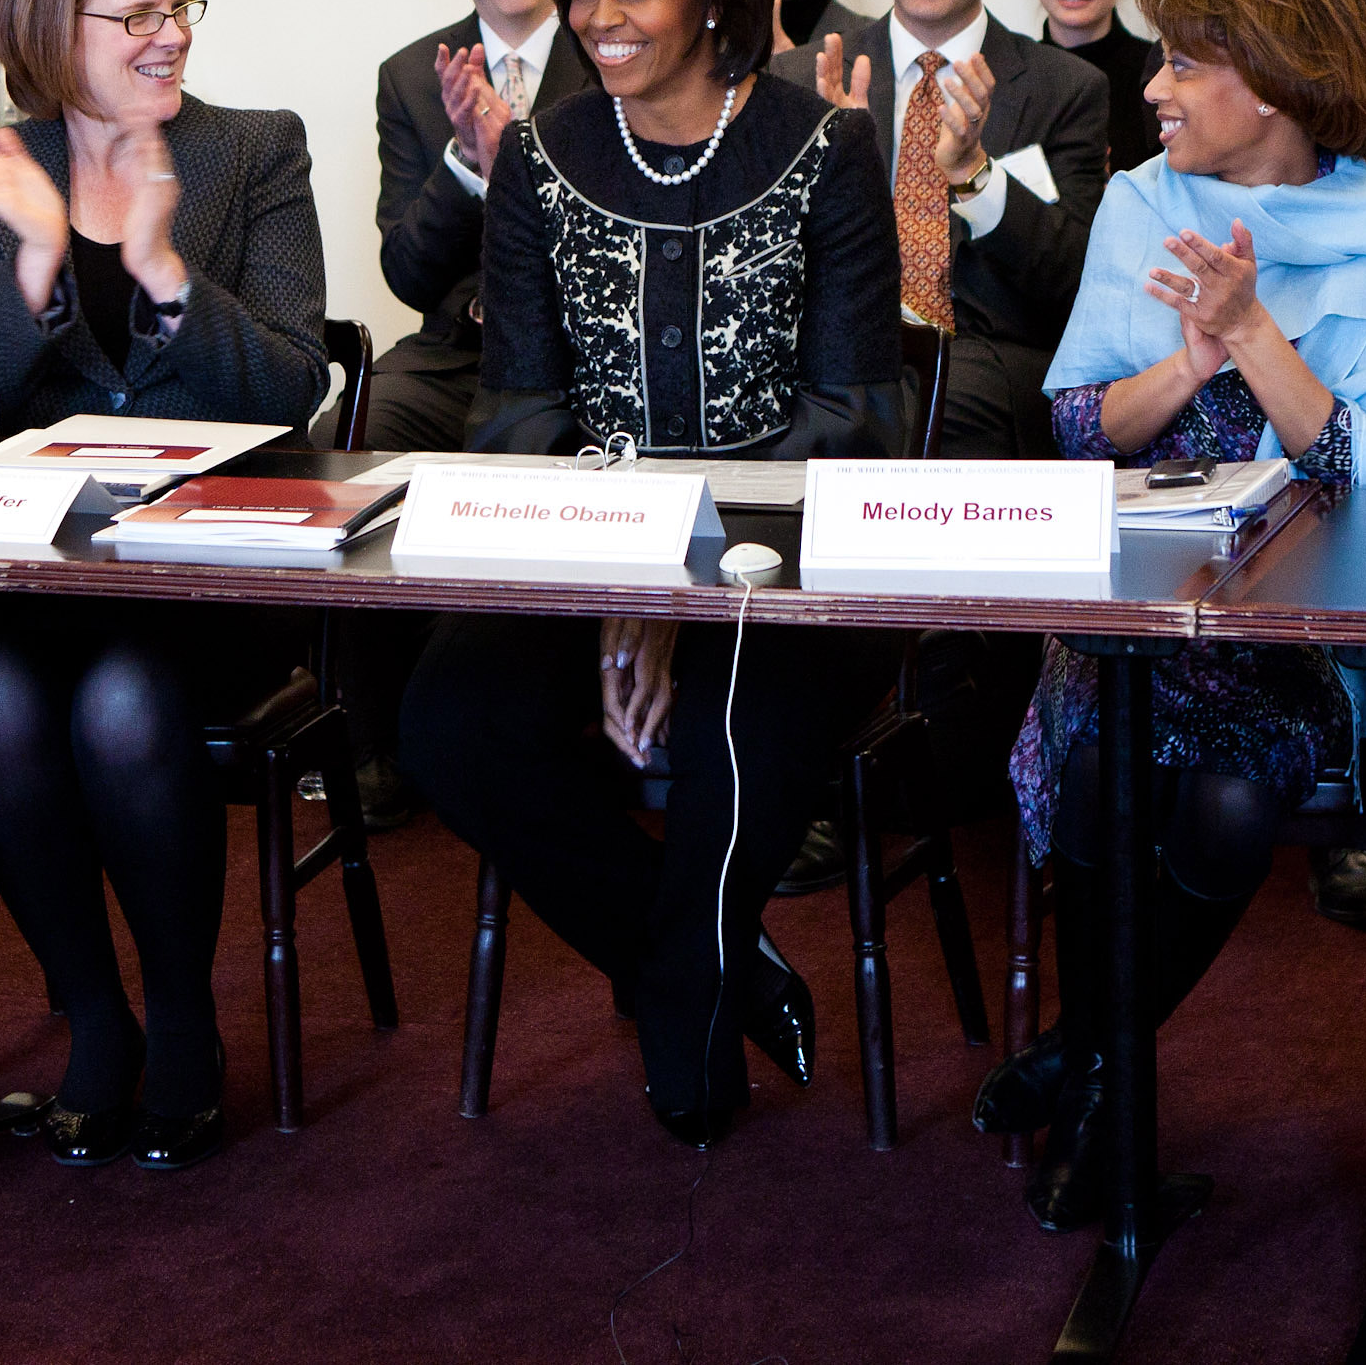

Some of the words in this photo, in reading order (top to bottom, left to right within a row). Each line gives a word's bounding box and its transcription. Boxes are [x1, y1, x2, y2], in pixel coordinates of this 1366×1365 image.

[450, 501, 551, 521] Michelle
[559, 505, 646, 524] Obama
[862, 502, 953, 525] Melody
[963, 502, 1054, 521] Barnes
